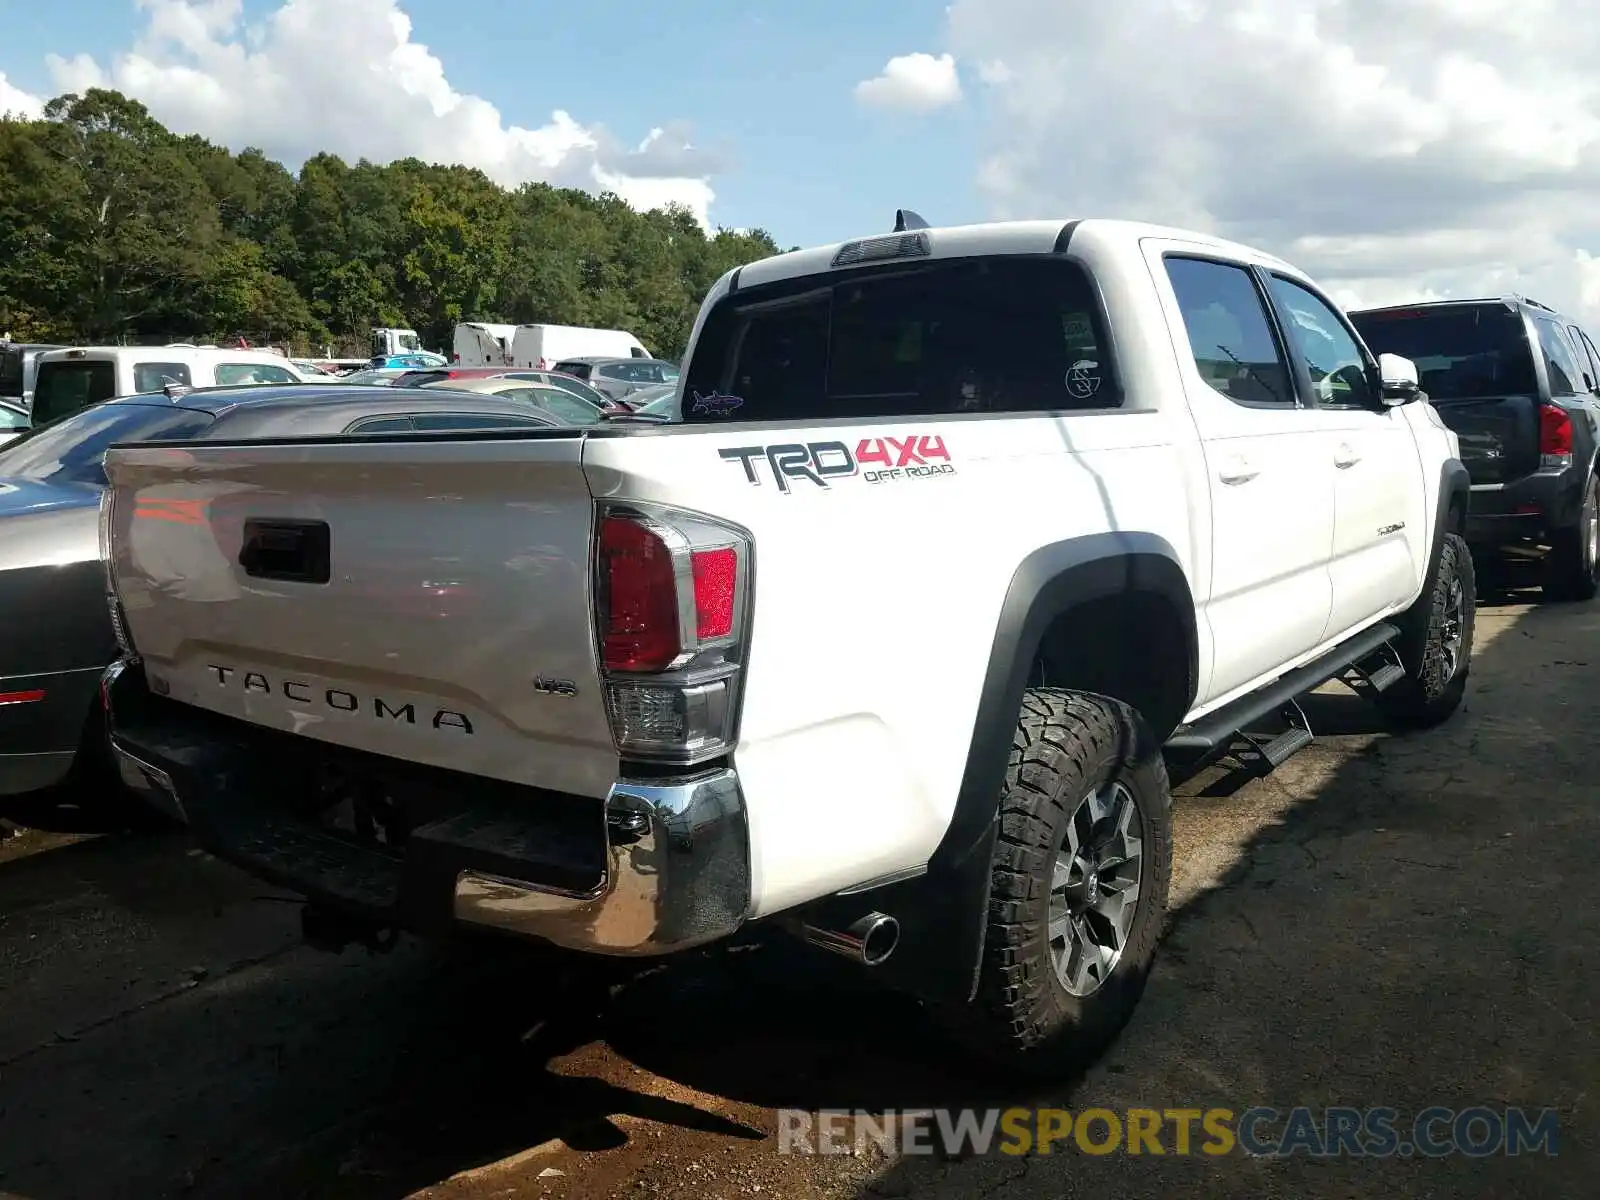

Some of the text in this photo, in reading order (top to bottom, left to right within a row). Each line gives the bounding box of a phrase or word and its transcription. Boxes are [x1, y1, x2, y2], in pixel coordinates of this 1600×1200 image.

[718, 435, 951, 494] TRD 4X4
[864, 464, 956, 483] OFF ROAD
[207, 664, 474, 734] TACOMA
